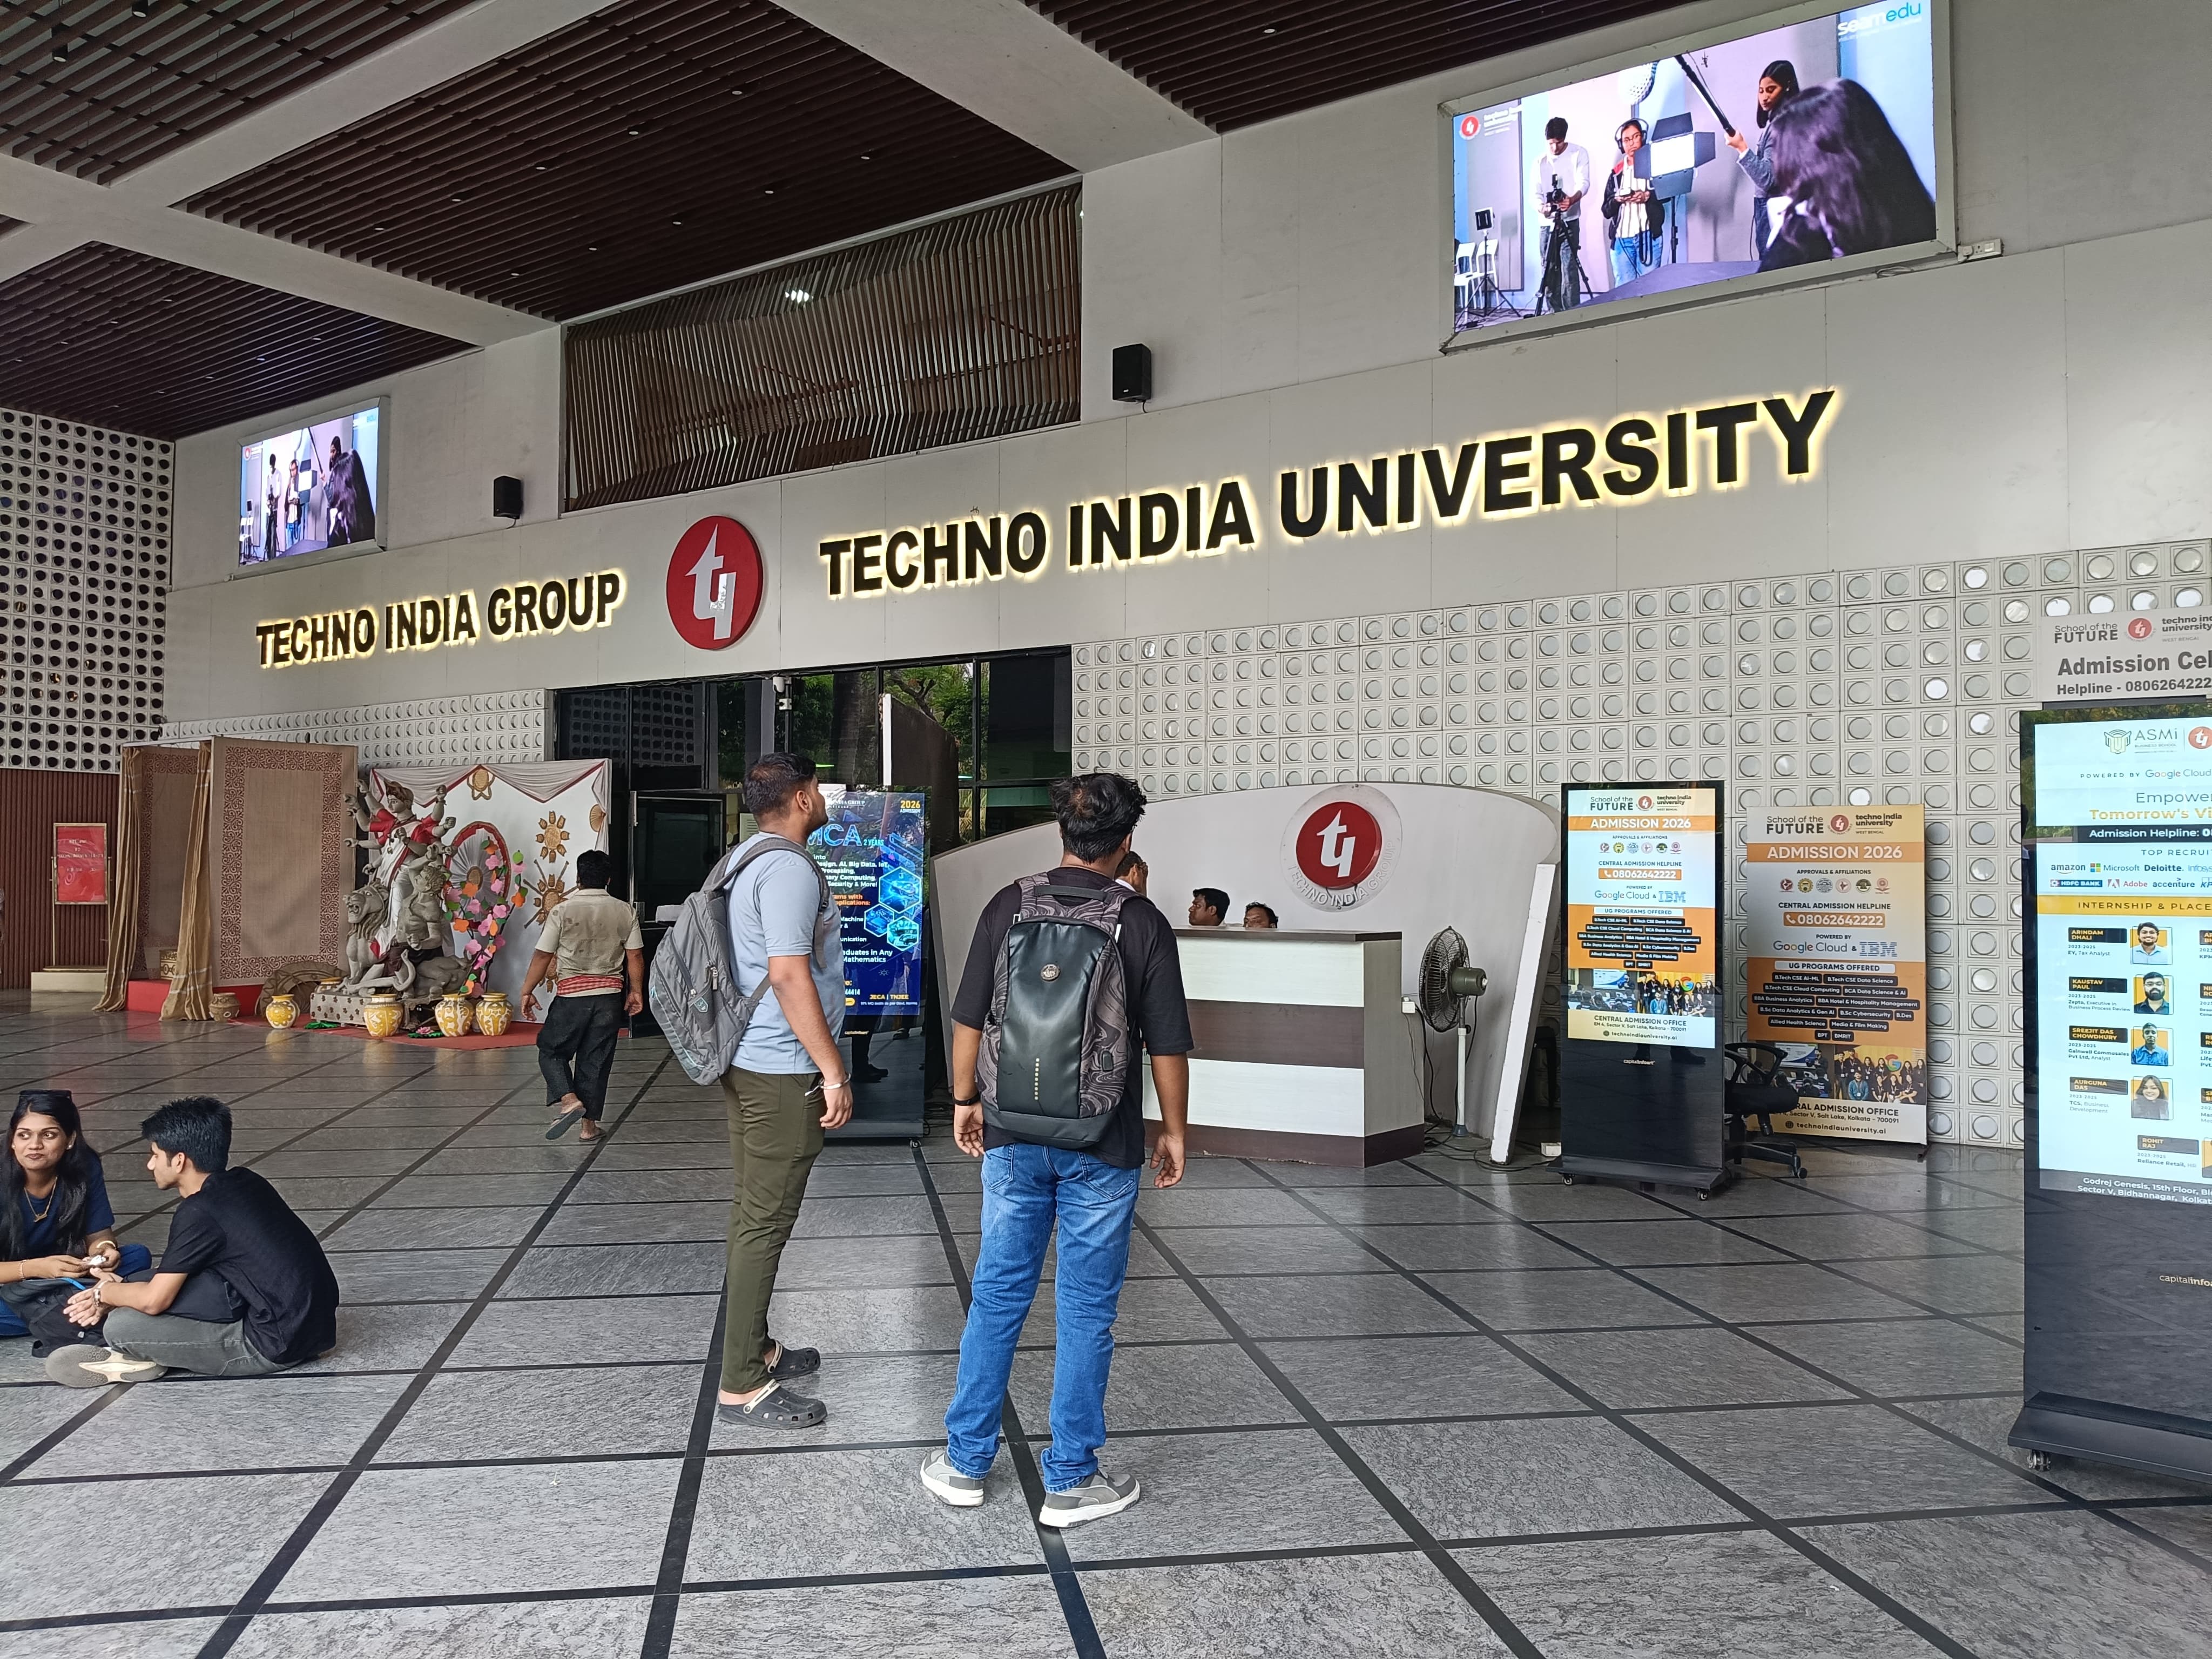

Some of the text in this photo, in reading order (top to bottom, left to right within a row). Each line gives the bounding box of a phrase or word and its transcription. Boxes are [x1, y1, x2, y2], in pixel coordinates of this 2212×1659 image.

[1838, 2, 1920, 36] seamedu
[821, 391, 1835, 596] TECHNO INDIA UNIVERSITY
[256, 573, 619, 665] TECHNO INDIA GROUP
[2055, 625, 2087, 633] School
[2054, 630, 2118, 643] FUTURE
[2058, 654, 2169, 676] Admission
[2058, 683, 2112, 696] Helpline
[2145, 770, 2181, 779] Google
[900, 800, 921, 808] 2026
[2089, 809, 2189, 820] Tomorrow's
[1590, 819, 1691, 828] ADMISSION 2026
[1767, 824, 1824, 834] FUTURE
[2089, 828, 2200, 838] Admission Helpline:
[1767, 846, 1903, 859] ADMISSION 2026
[1288, 841, 1395, 907] TECHNO INDIA GROUP
[1613, 870, 1676, 879] 08062642222
[1595, 891, 1624, 900] Google
[1658, 891, 1686, 902] IBM
[1797, 914, 1883, 926] 08062642222
[1773, 941, 1813, 954] Google
[1816, 942, 1847, 952] Cloud
[1859, 941, 1897, 957] IBM
[1814, 1104, 1864, 1114] ADMISSION
[1867, 1108, 1899, 1116] OFFICE
[1797, 1123, 1886, 1135] technoindiauniversity.ai
[2083, 1177, 2112, 1186] Godrej
[2114, 1181, 2150, 1190] Genesis,
[2173, 1186, 2199, 1195] Floor,
[2078, 1185, 2105, 1193] Sector
[2118, 1190, 2177, 1202] Bidhannagar,
